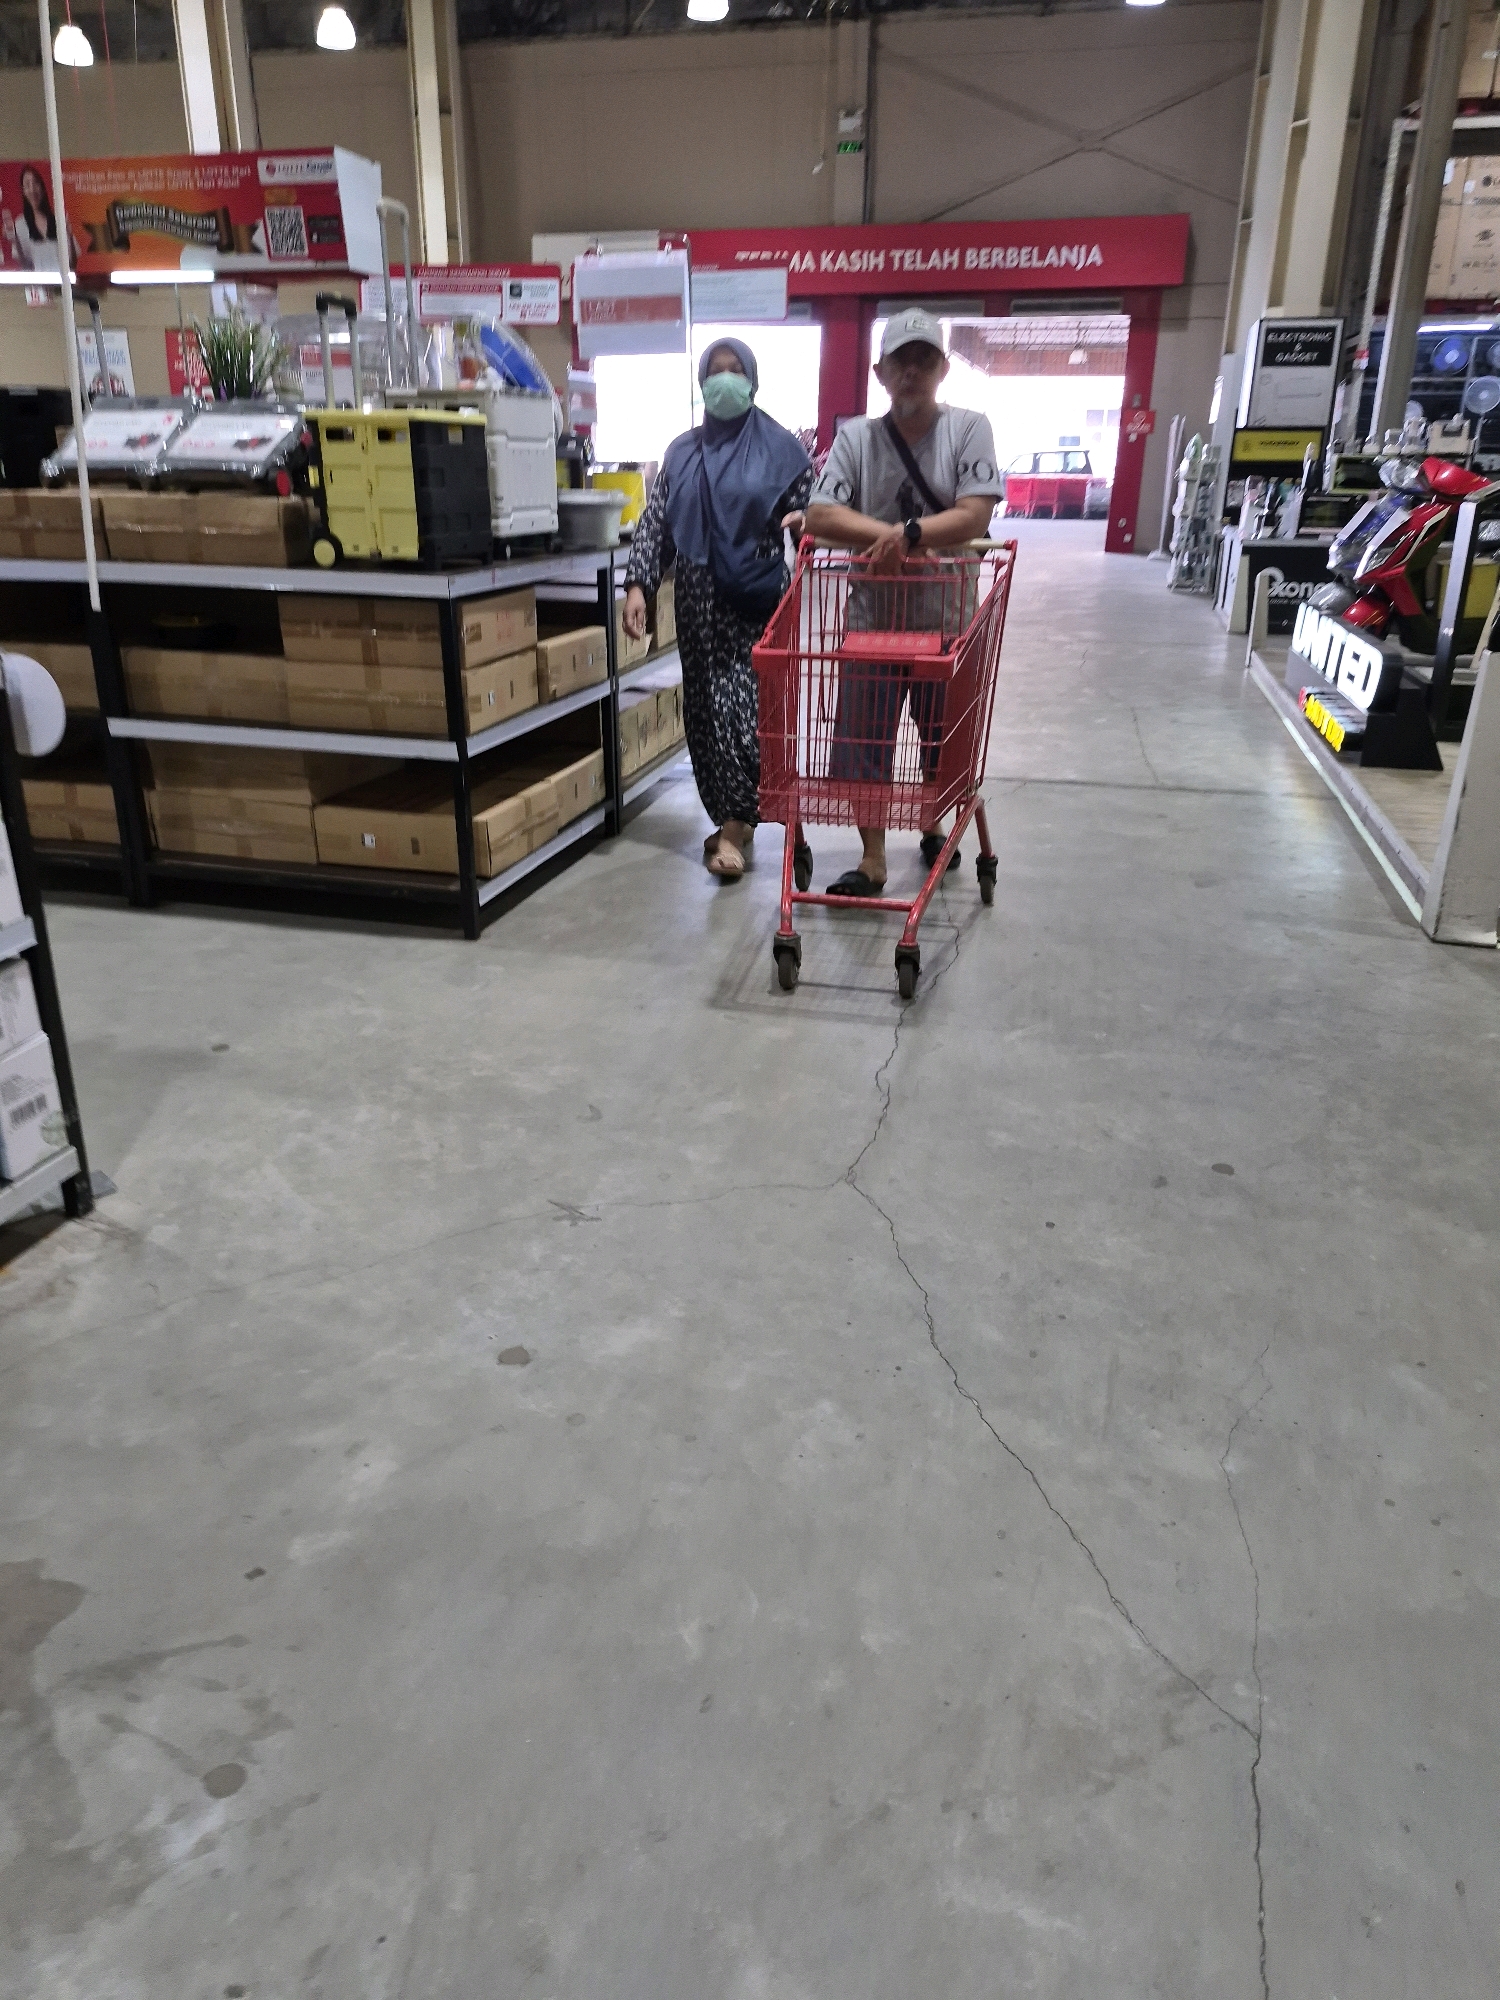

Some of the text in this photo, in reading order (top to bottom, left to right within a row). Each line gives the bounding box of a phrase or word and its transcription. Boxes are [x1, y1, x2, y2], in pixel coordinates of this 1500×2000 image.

[820, 249, 885, 273] KASIH
[889, 248, 961, 272] TELAH
[965, 243, 1103, 271] BERBELANJA
[1266, 332, 1332, 344] ELECTRONIC
[1275, 352, 1320, 363] GADGET
[1292, 602, 1384, 709] UNITED
